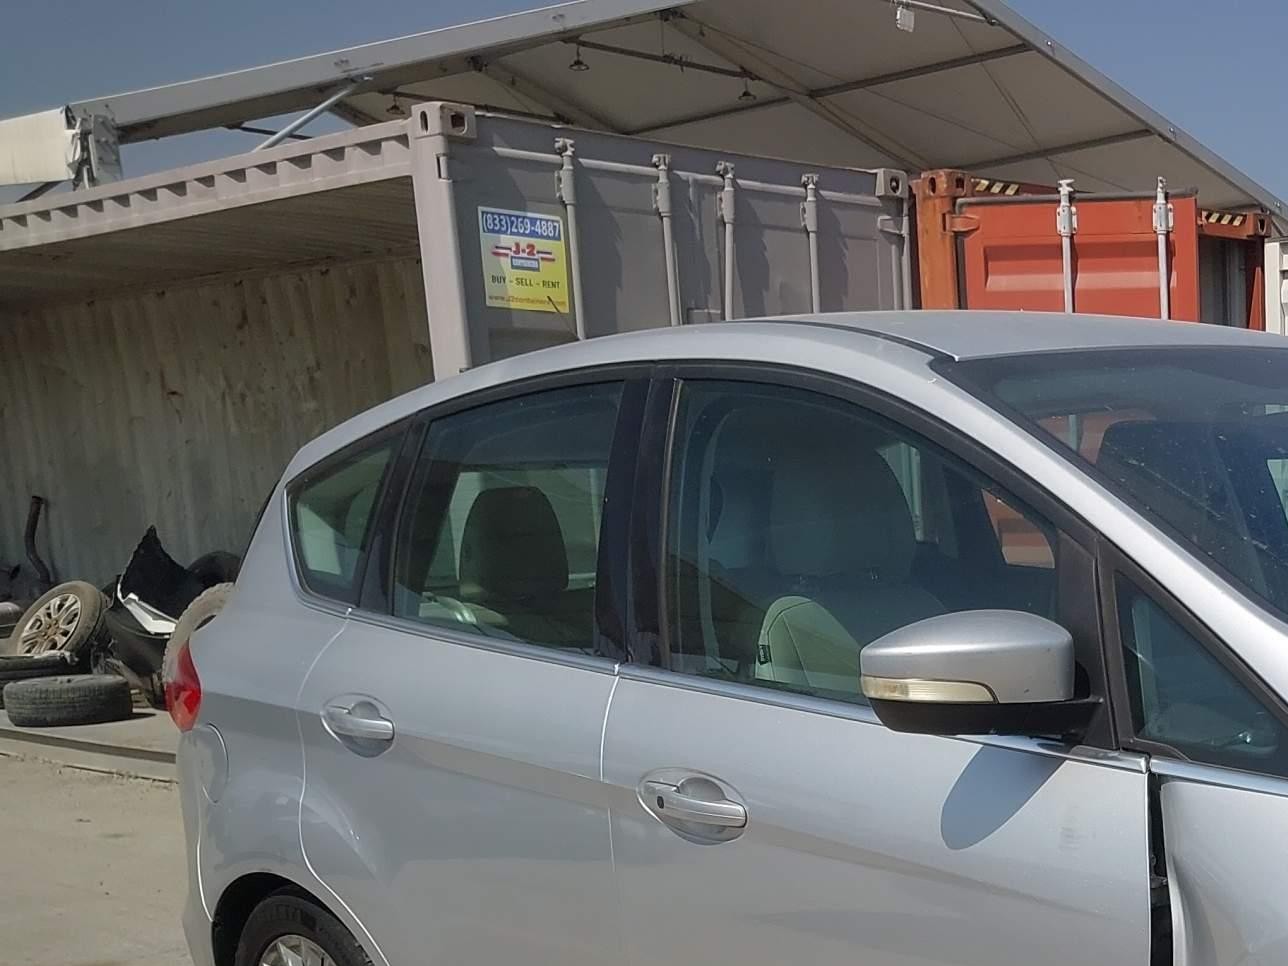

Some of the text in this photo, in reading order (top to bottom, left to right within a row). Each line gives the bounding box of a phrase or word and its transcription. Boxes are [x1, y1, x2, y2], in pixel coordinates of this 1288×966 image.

[482, 213, 560, 238] (833)269-4887
[491, 275, 507, 285] BUY
[515, 278, 534, 288] SELL
[542, 280, 561, 289] RENT
